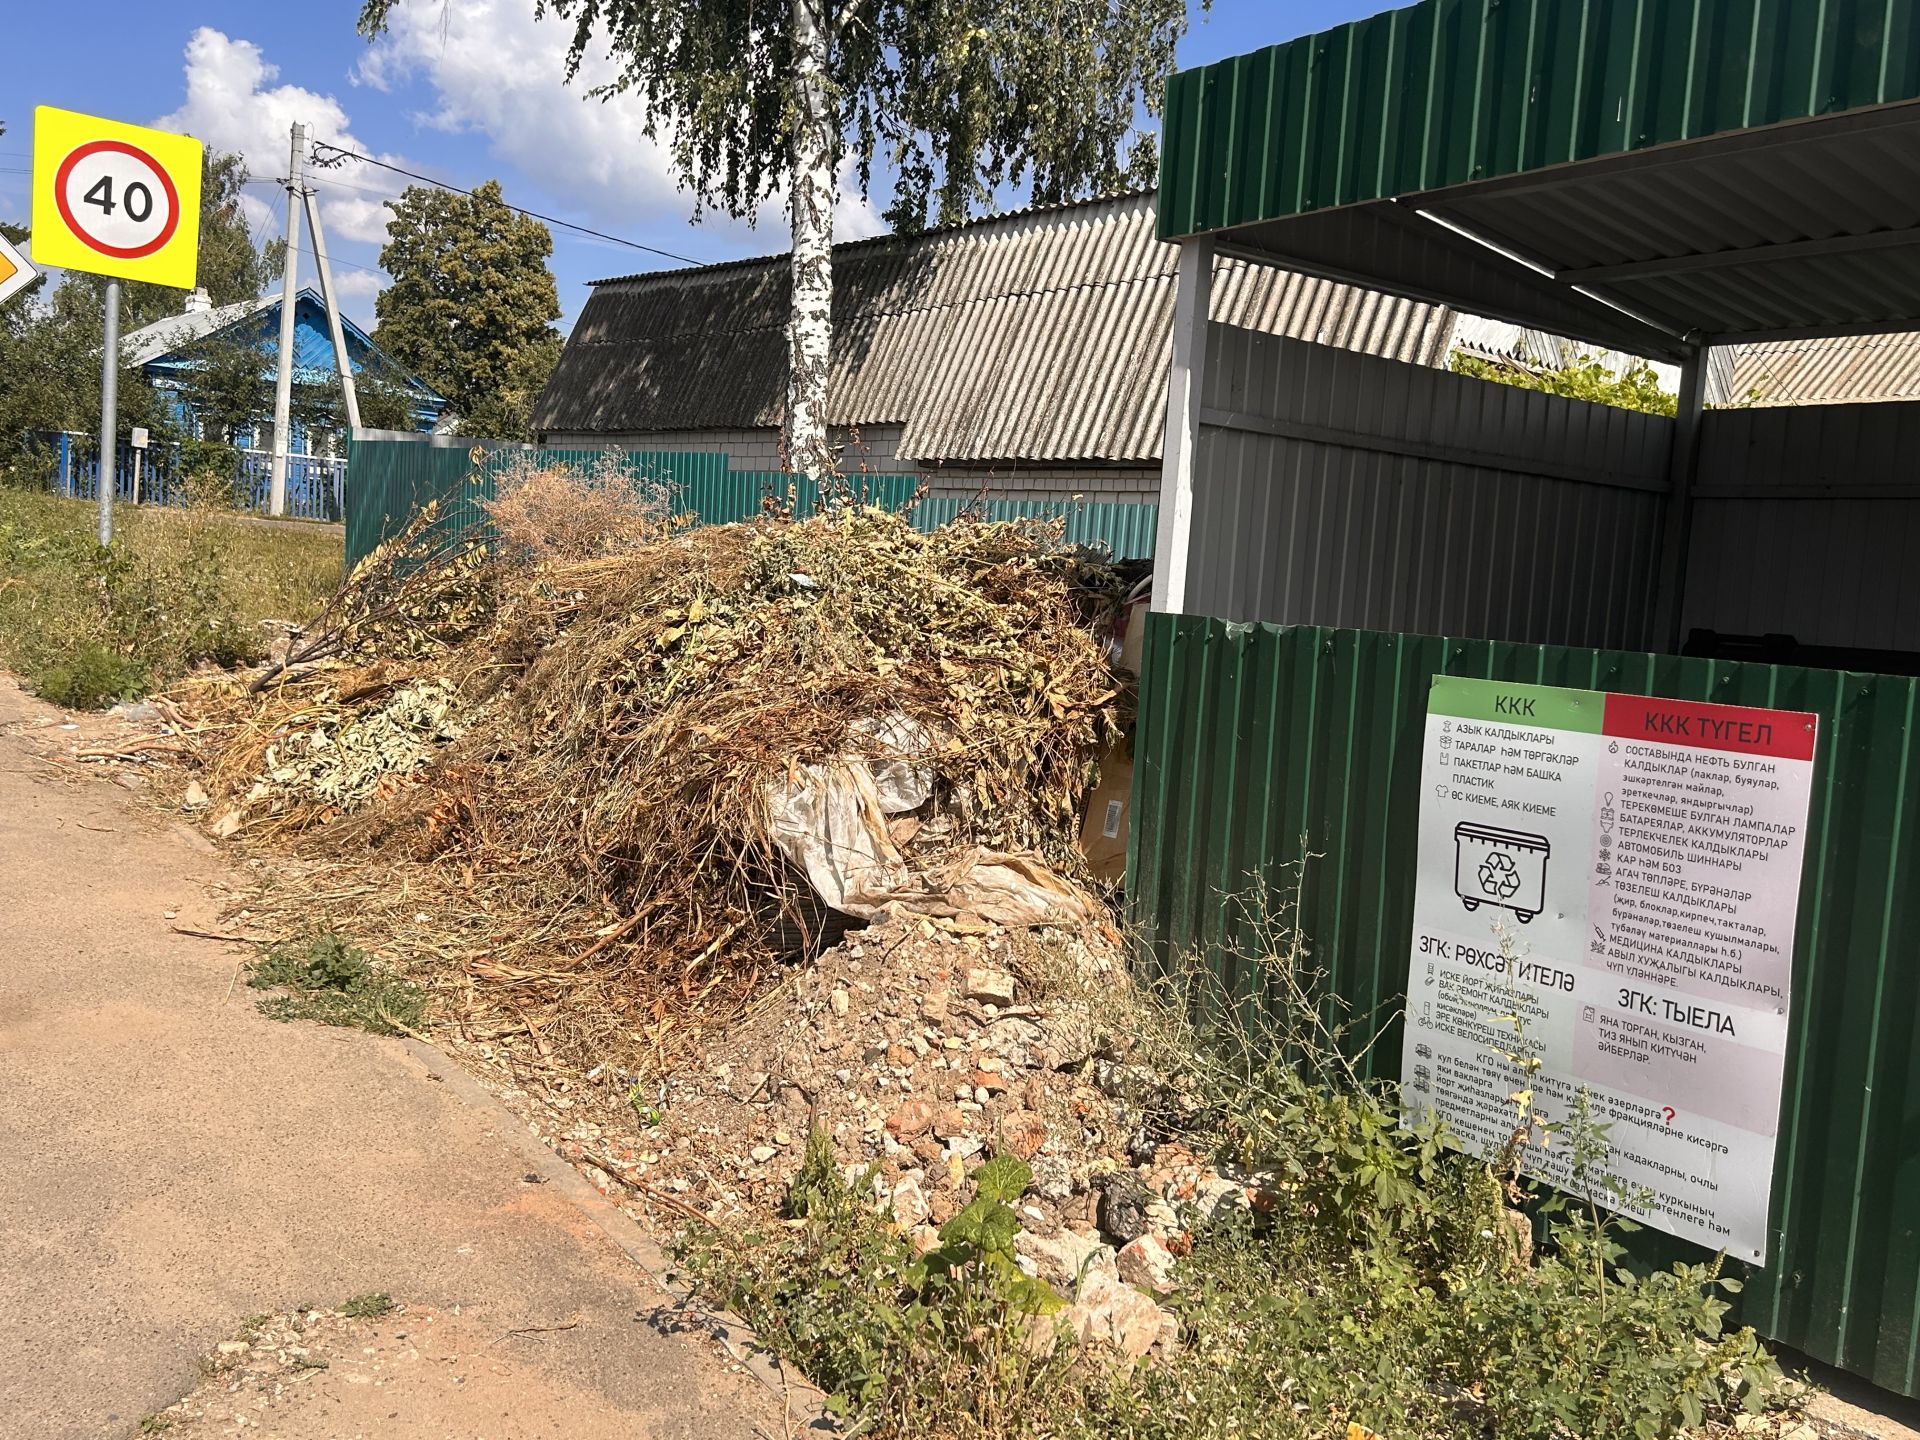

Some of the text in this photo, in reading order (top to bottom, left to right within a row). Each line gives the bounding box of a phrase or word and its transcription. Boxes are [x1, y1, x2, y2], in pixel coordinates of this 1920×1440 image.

[84, 175, 153, 223] 40
[1494, 695, 1536, 717] ККК
[1456, 724, 1555, 745] АЗЫК КАЛДЫКЛАРЫ
[1644, 711, 1772, 745] ККК ТҮГЕЛ
[1455, 740, 1496, 754] ТАРАЛАР
[1523, 750, 1579, 766] ТӨРГӘКЛӘР
[1626, 745, 1776, 774] СОСТАВЫНДА НЕФТЬ БУЛГАН
[1452, 774, 1494, 789] ПЛАСТИК
[1454, 757, 1501, 772] ПАКЕТЛАР
[1526, 768, 1562, 782] БАШКА
[1624, 759, 1779, 790] КАЛДЫКЛАР (лаклар, буяулар,
[1622, 774, 1724, 797] эшкәртелгән майлар,
[1452, 790, 1556, 816] ӨС КИЕМЕ, АЯК КИЕМЕ
[1622, 788, 1754, 816] эреткечләр, яндыргычлар)
[1620, 800, 1796, 836] ТЕРЕКӨМЕШЕ БУЛГАН ЛАМПАЛАР
[1620, 813, 1788, 850] БАТАРЕЯЛАР, АККУМУЛЯТОРЛАР
[1618, 826, 1768, 862] ТЕРЛЕКЧЕЛЕК КАЛДЫКЛАРЫ
[1618, 840, 1742, 872] АВТОМОБИЛЬ ШИННАРЫ
[1617, 854, 1636, 864] КАР
[1662, 862, 1682, 874] БОЗ
[1615, 880, 1737, 914] ТӨЗЕЛЕШ КАЛДЫКЛАРЫ
[1616, 868, 1752, 902] АГАЧ ТӨПЛӘРЕ, БҮРӘНӘЛӘР
[1611, 922, 1646, 938] түбәләү
[1649, 932, 1718, 954] материаллары
[1704, 930, 1780, 954] кушылмалары,
[1419, 935, 1575, 992] ЗГК: РӨХСӘ ИТЕЛӘ
[1606, 960, 1624, 972] ЧҮП
[1608, 948, 1635, 962] АВЫЛ
[1638, 954, 1696, 978] ХУҖАЛЫГЫ
[1610, 934, 1742, 974] МЕДИЦИНА КАЛДЫКЛАРЫ
[1440, 970, 1461, 982] ИСКЕ
[1462, 974, 1484, 988] ЙОРТ
[1618, 988, 1736, 1036] ЗГК: ТЫЕЛА
[1435, 1021, 1456, 1034] ИСКЕ
[1600, 1015, 1706, 1054] ЯНА ТОРГАН, КЫЗГАН,
[1598, 1028, 1697, 1064] ТИЗ ЯНЫП КИТҮЧӘН
[1476, 1052, 1494, 1066] КГО
[1496, 1061, 1510, 1071] ны
[1436, 1073, 1456, 1087] йорт
[1437, 1064, 1492, 1088] яки вакларга
[1436, 1098, 1498, 1124] предметларны
[1438, 1054, 1452, 1064] кул
[1454, 1058, 1479, 1072] белән
[1504, 1076, 1526, 1087] өчен
[1608, 1107, 1684, 1140] фракцияләрне
[1686, 1134, 1729, 1154] кисәргә
[1690, 1175, 1718, 1192] очлы
[1659, 1192, 1715, 1218] куркыныч
